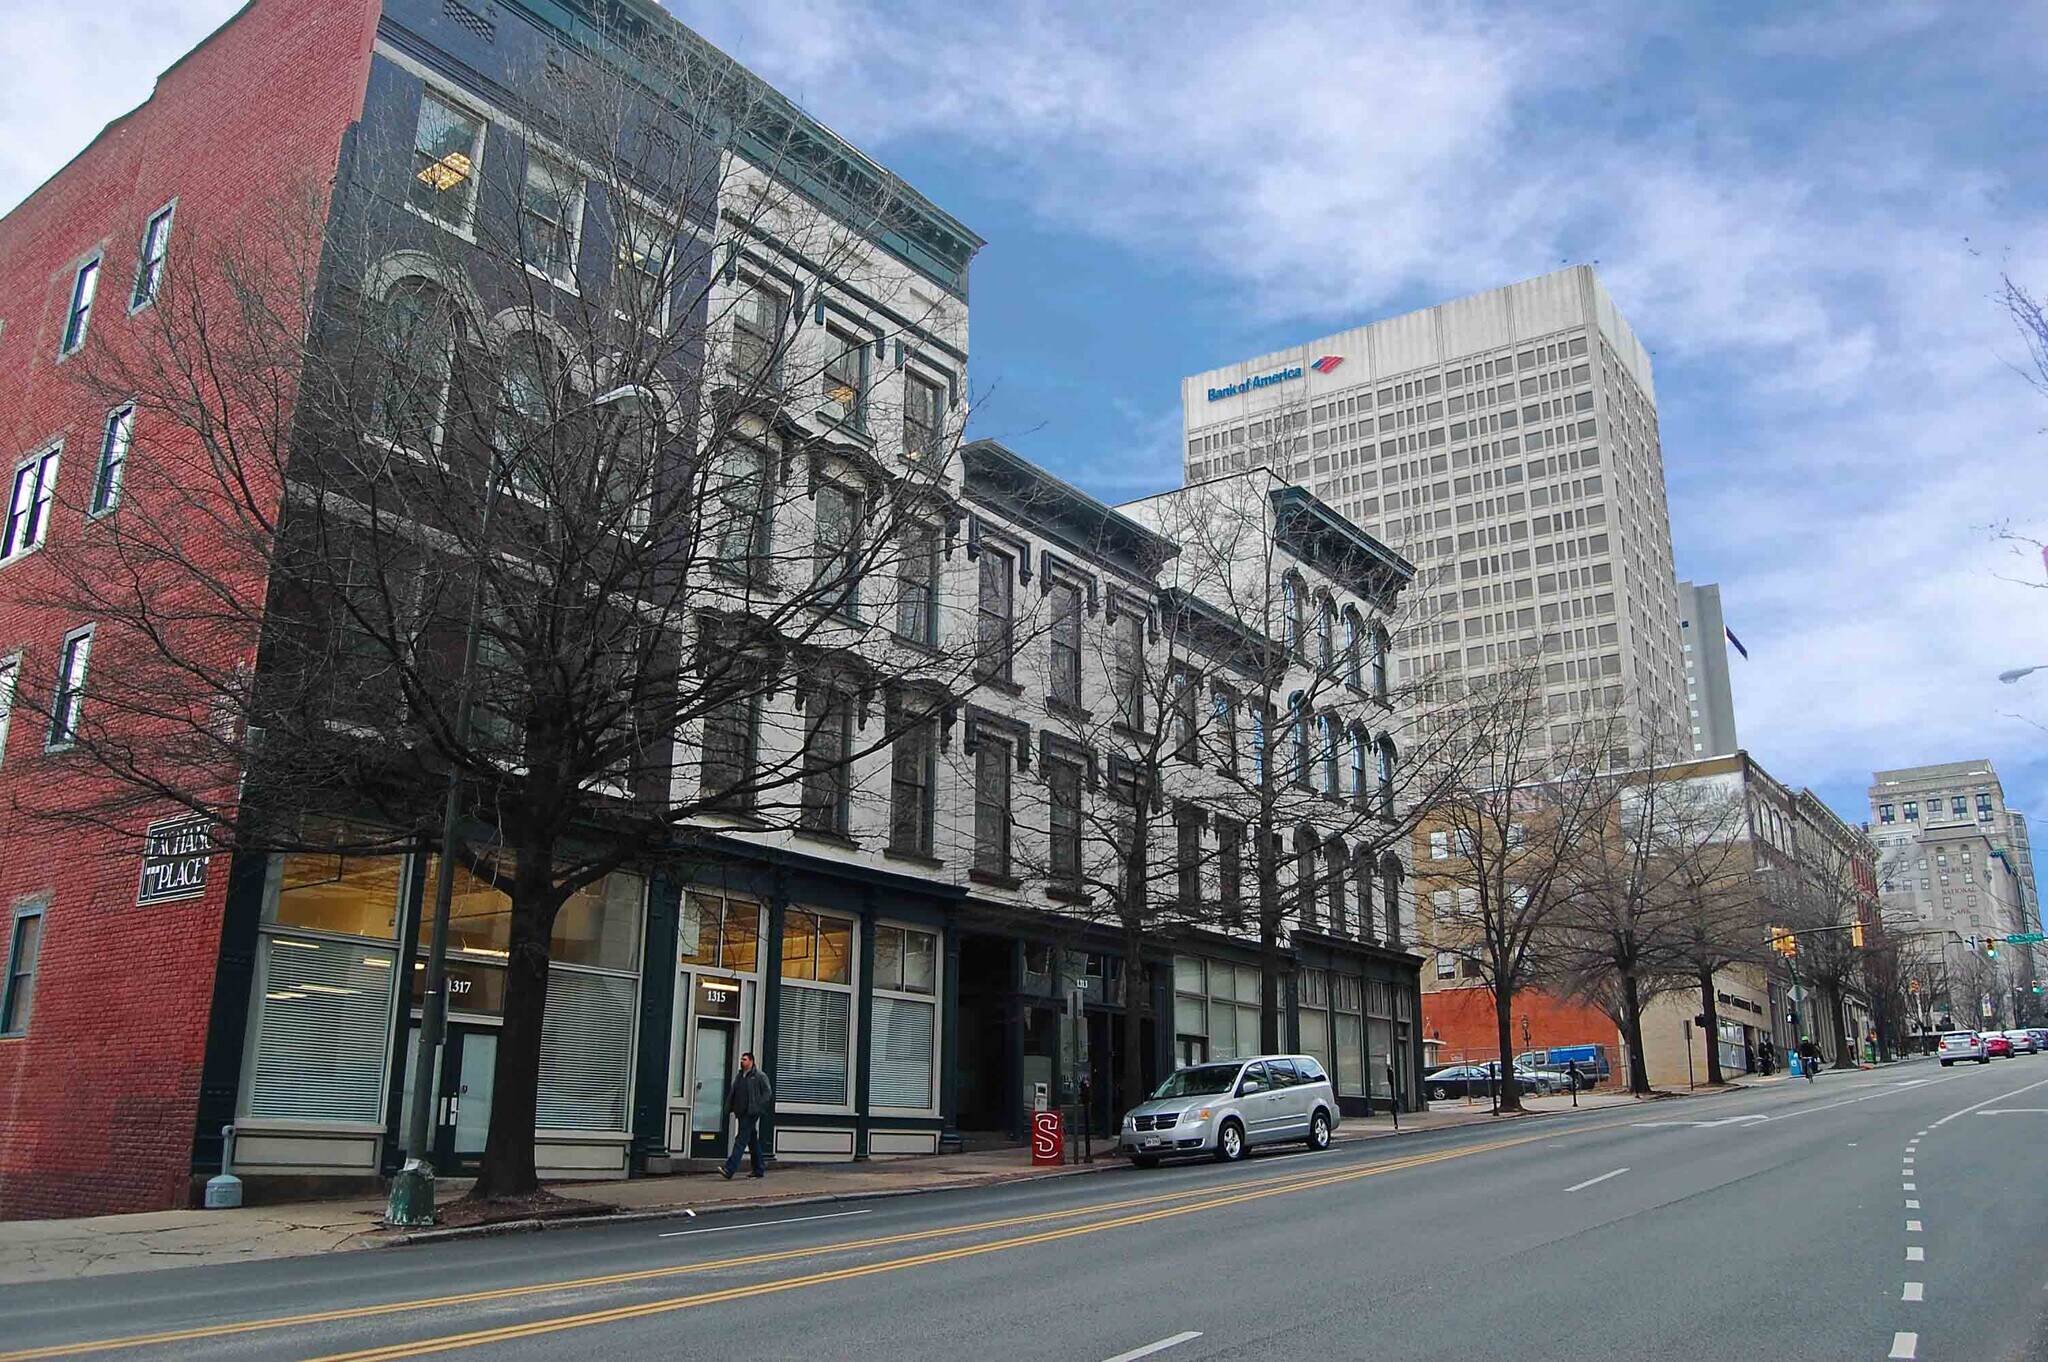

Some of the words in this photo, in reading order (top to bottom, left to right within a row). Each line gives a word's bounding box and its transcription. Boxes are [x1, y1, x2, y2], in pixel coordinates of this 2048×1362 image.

[1208, 384, 1236, 402] Bank
[1238, 378, 1250, 393] of
[1252, 367, 1303, 388] America
[157, 857, 204, 890] PLACE
[707, 990, 726, 1002] 1315
